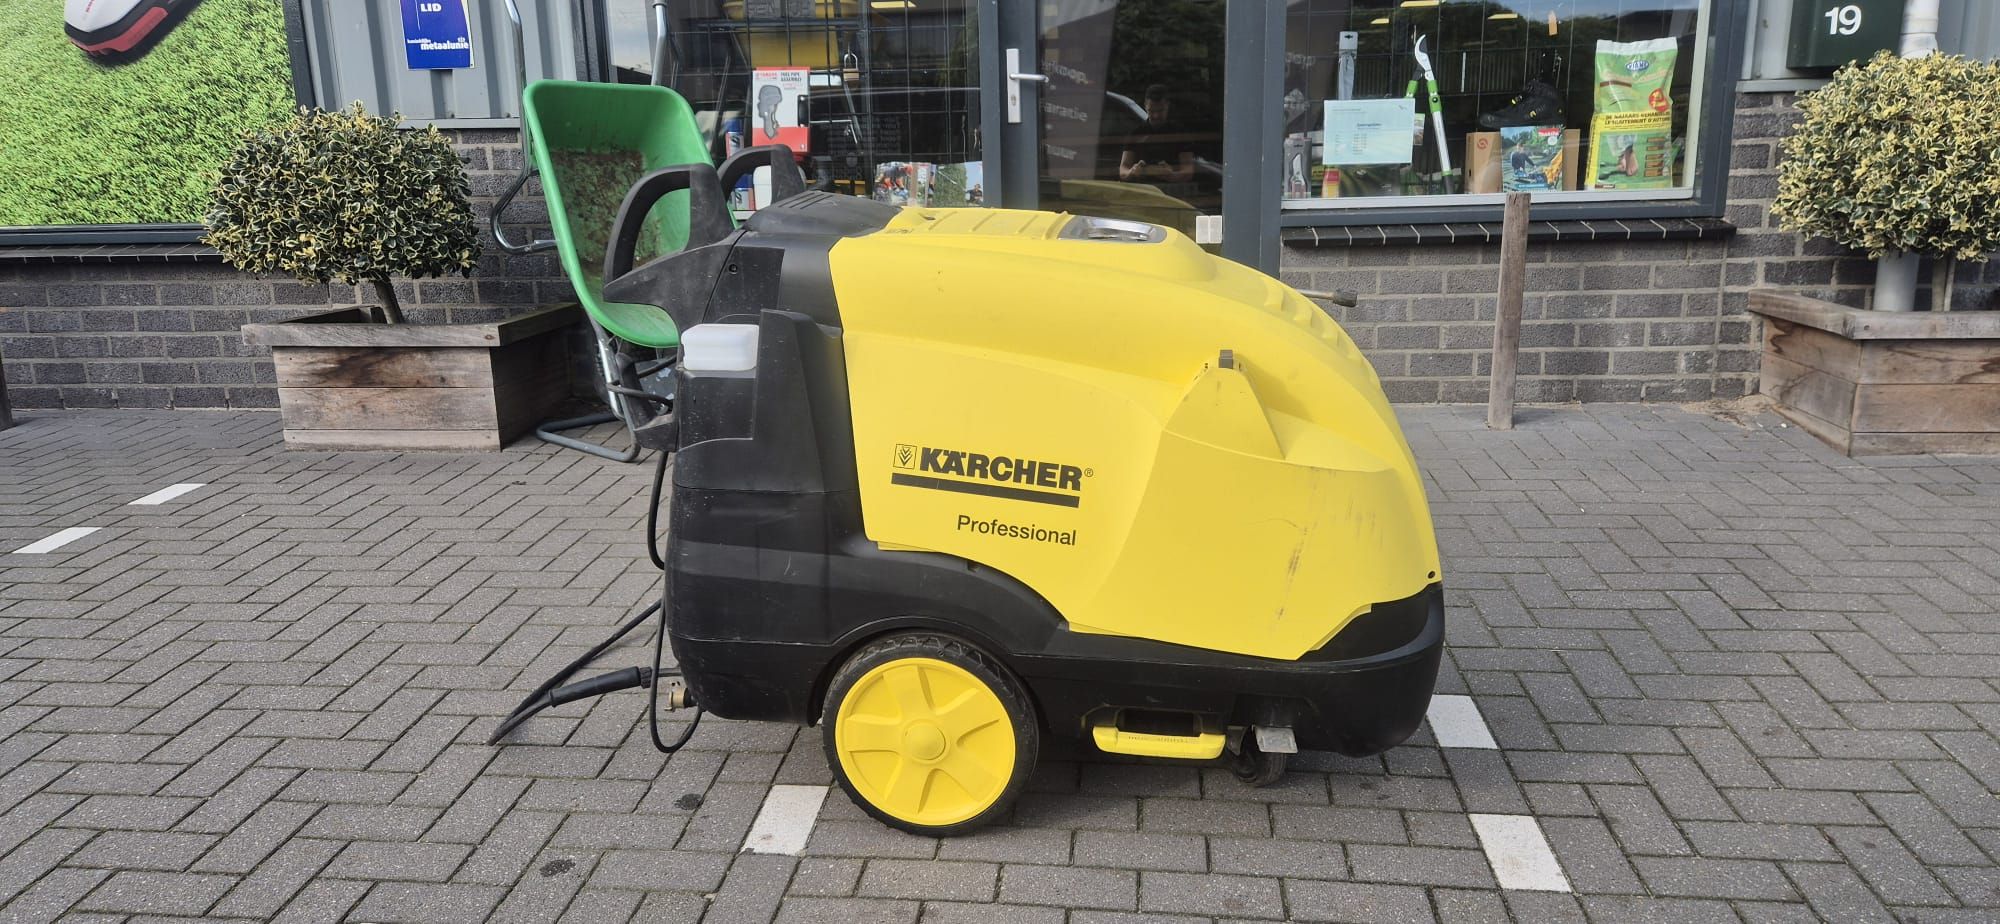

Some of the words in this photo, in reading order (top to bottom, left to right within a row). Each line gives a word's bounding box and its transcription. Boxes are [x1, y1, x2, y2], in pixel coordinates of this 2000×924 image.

[420, 3, 442, 12] LID
[1824, 4, 1862, 36] 19
[420, 40, 469, 50] metaalunie
[919, 447, 1083, 491] KÄRCHER
[957, 514, 1077, 546] Professional
